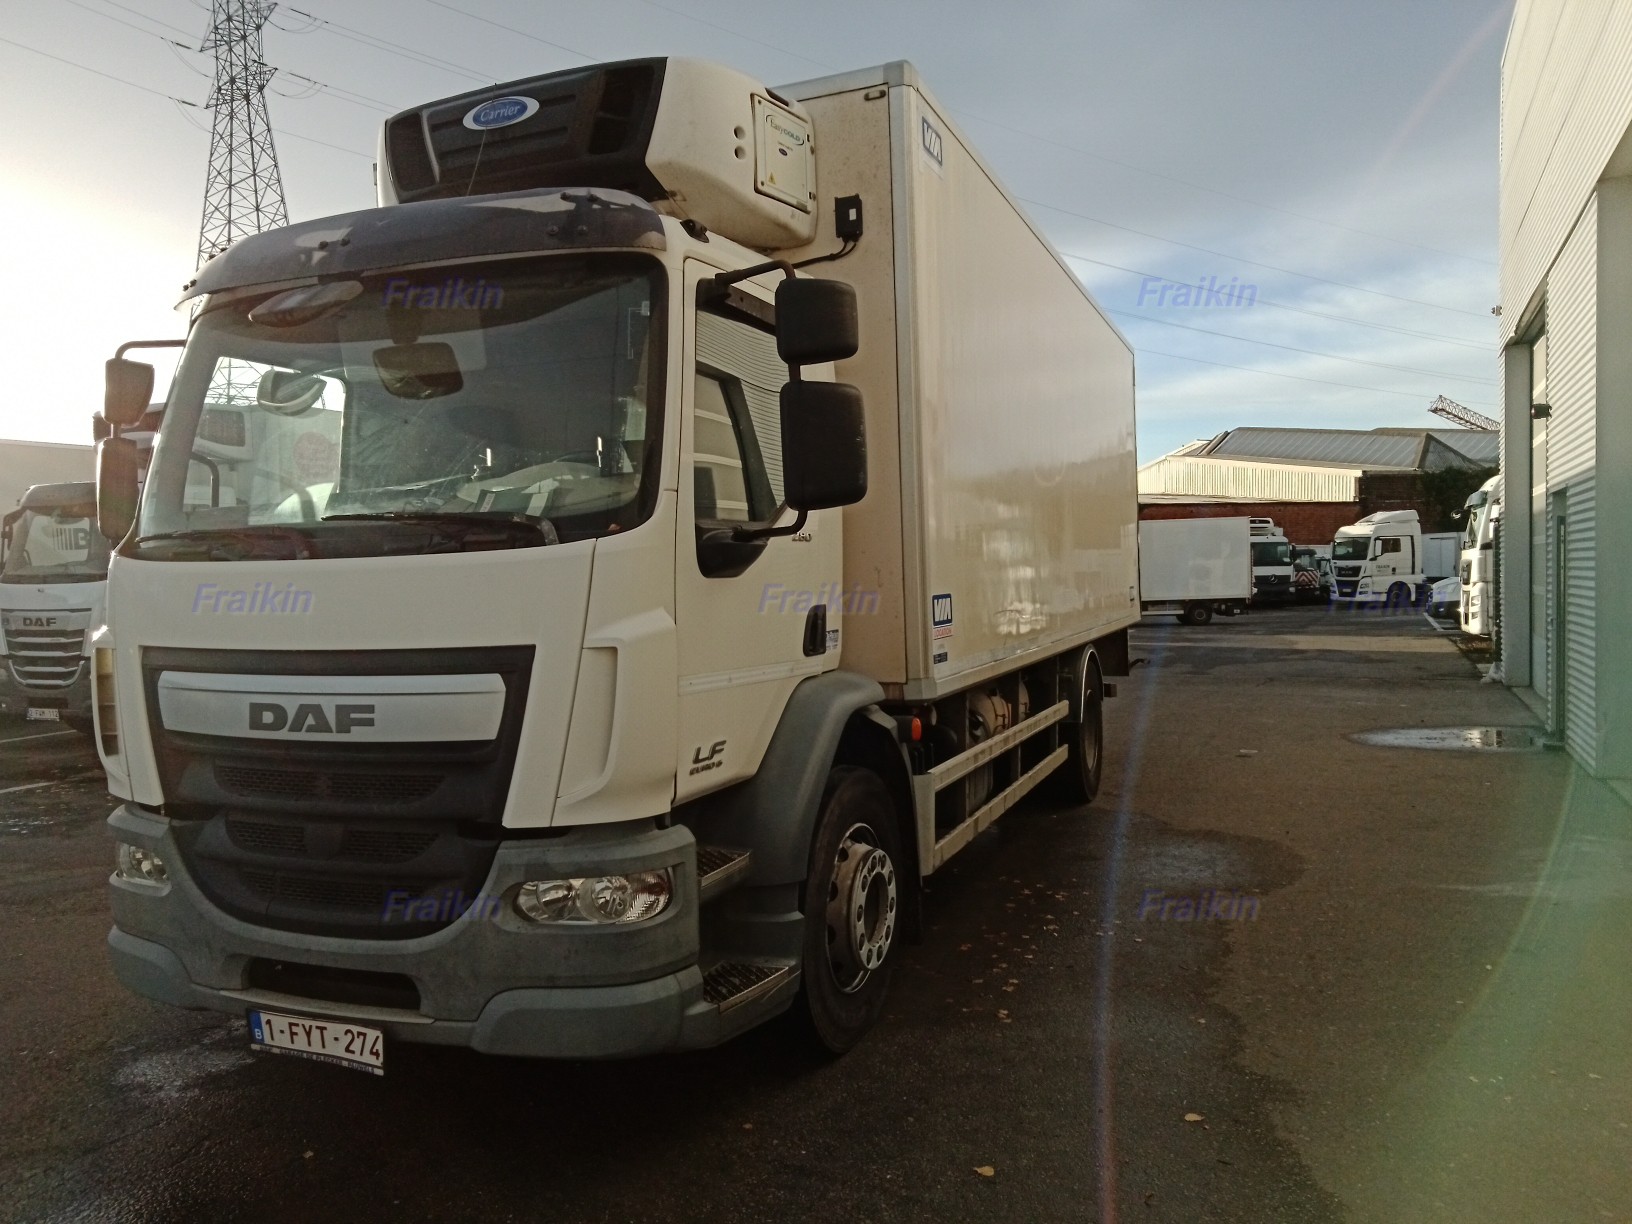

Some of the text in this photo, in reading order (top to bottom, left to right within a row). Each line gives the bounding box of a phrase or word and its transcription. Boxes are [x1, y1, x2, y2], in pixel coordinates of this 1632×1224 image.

[480, 104, 521, 122] Carrier
[22, 617, 57, 627] DAF
[249, 702, 375, 733] DAF
[692, 739, 727, 765] LF
[254, 1028, 263, 1040] B
[265, 1018, 381, 1061] 1-FYT-274
